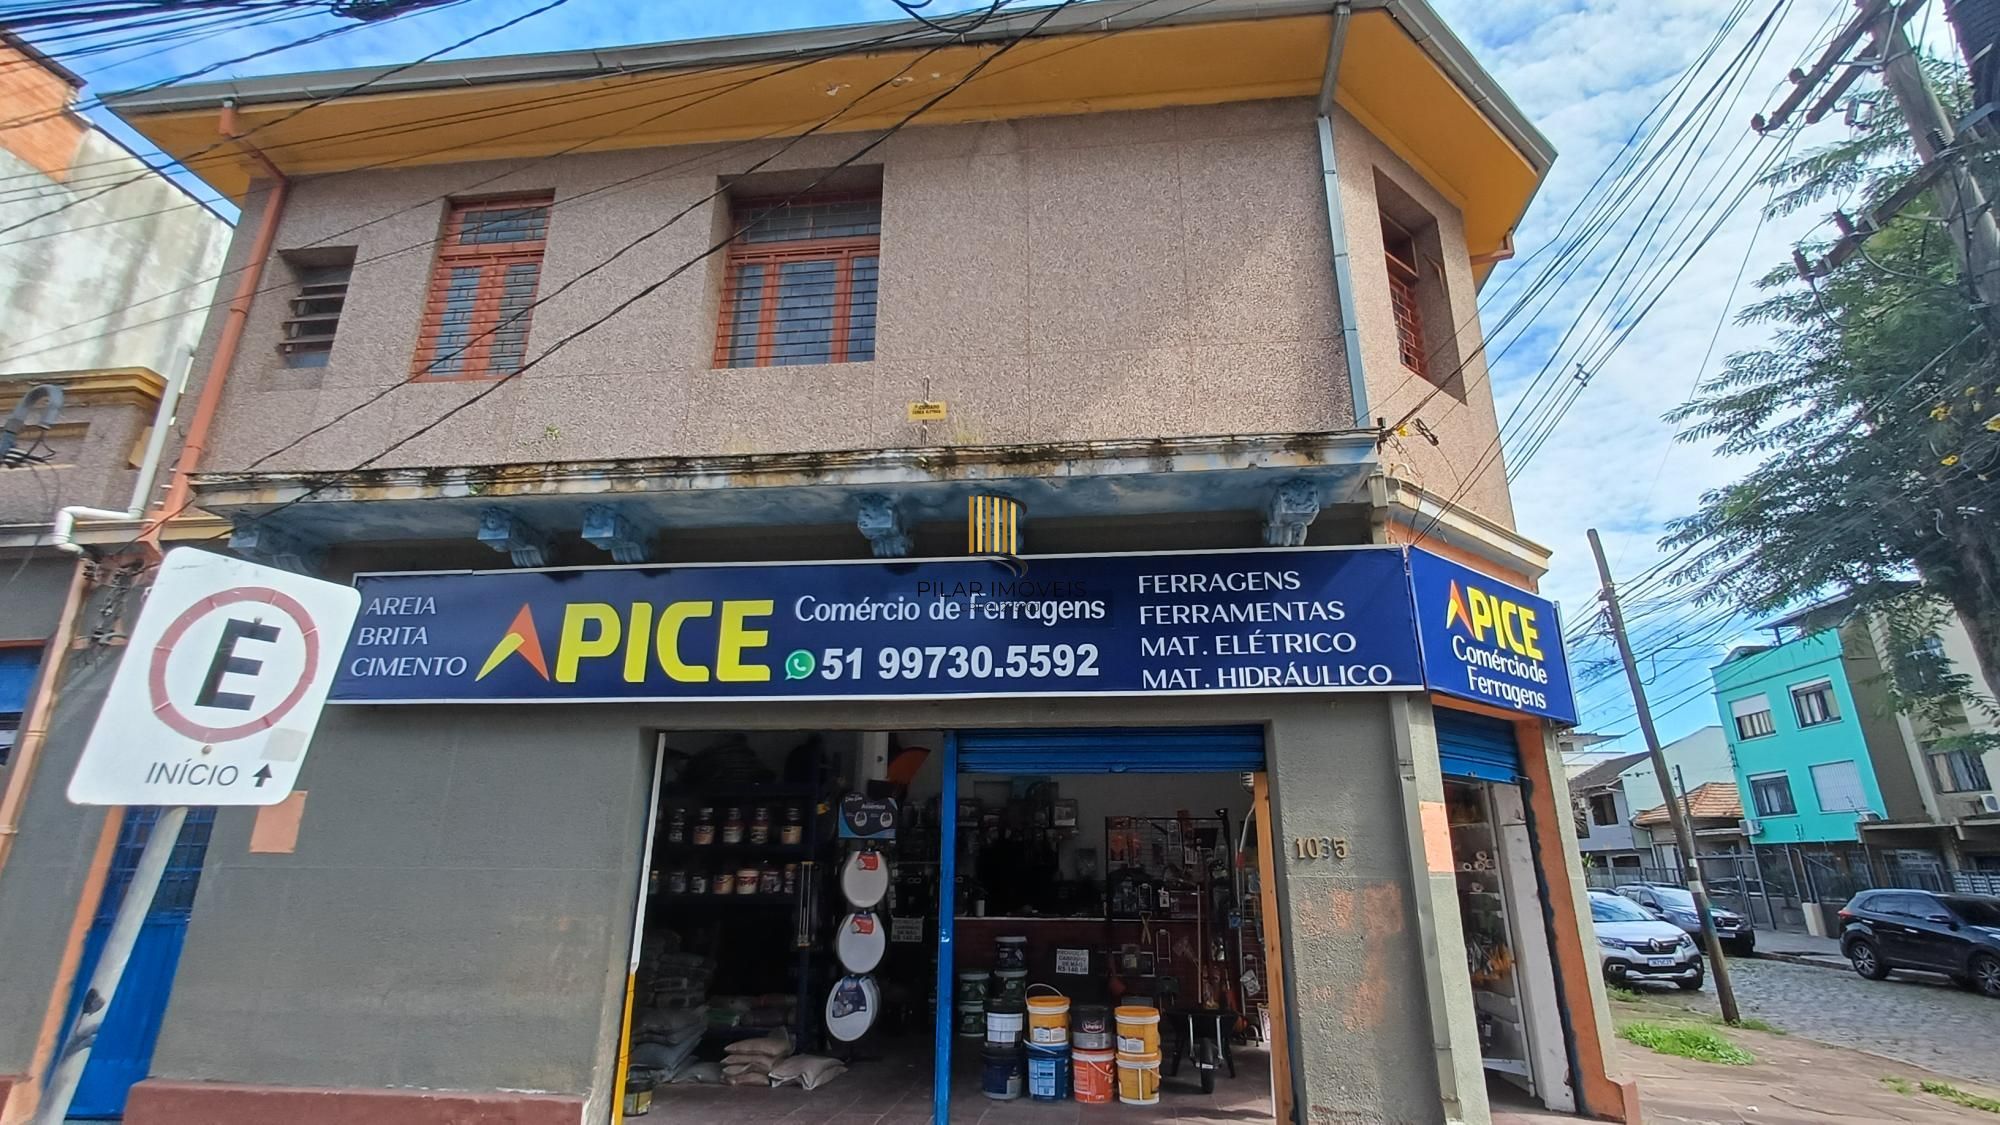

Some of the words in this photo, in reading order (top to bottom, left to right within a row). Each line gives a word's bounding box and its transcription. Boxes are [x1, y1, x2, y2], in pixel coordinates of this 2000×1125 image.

[1138, 570, 1301, 594] FERRAGENS
[366, 597, 436, 615] AREIA
[795, 595, 921, 622] Comércio
[929, 593, 961, 620] de
[969, 593, 1106, 627] Ferragens
[1140, 600, 1346, 625] FERRAMENTAS
[357, 627, 428, 646] BRITA
[1141, 636, 1208, 657] MAT.
[1215, 629, 1357, 655] ELÉTRICO
[194, 618, 281, 711] E
[351, 657, 467, 677] CIMENTO
[821, 647, 863, 680] 51
[878, 643, 1100, 679] 99730.5592
[1142, 668, 1211, 689] MAT.
[1217, 662, 1393, 688] HIDRÁULICO
[1467, 665, 1548, 709] Ferragens
[145, 758, 239, 787] INÍCIO
[1295, 836, 1346, 859] 1035
